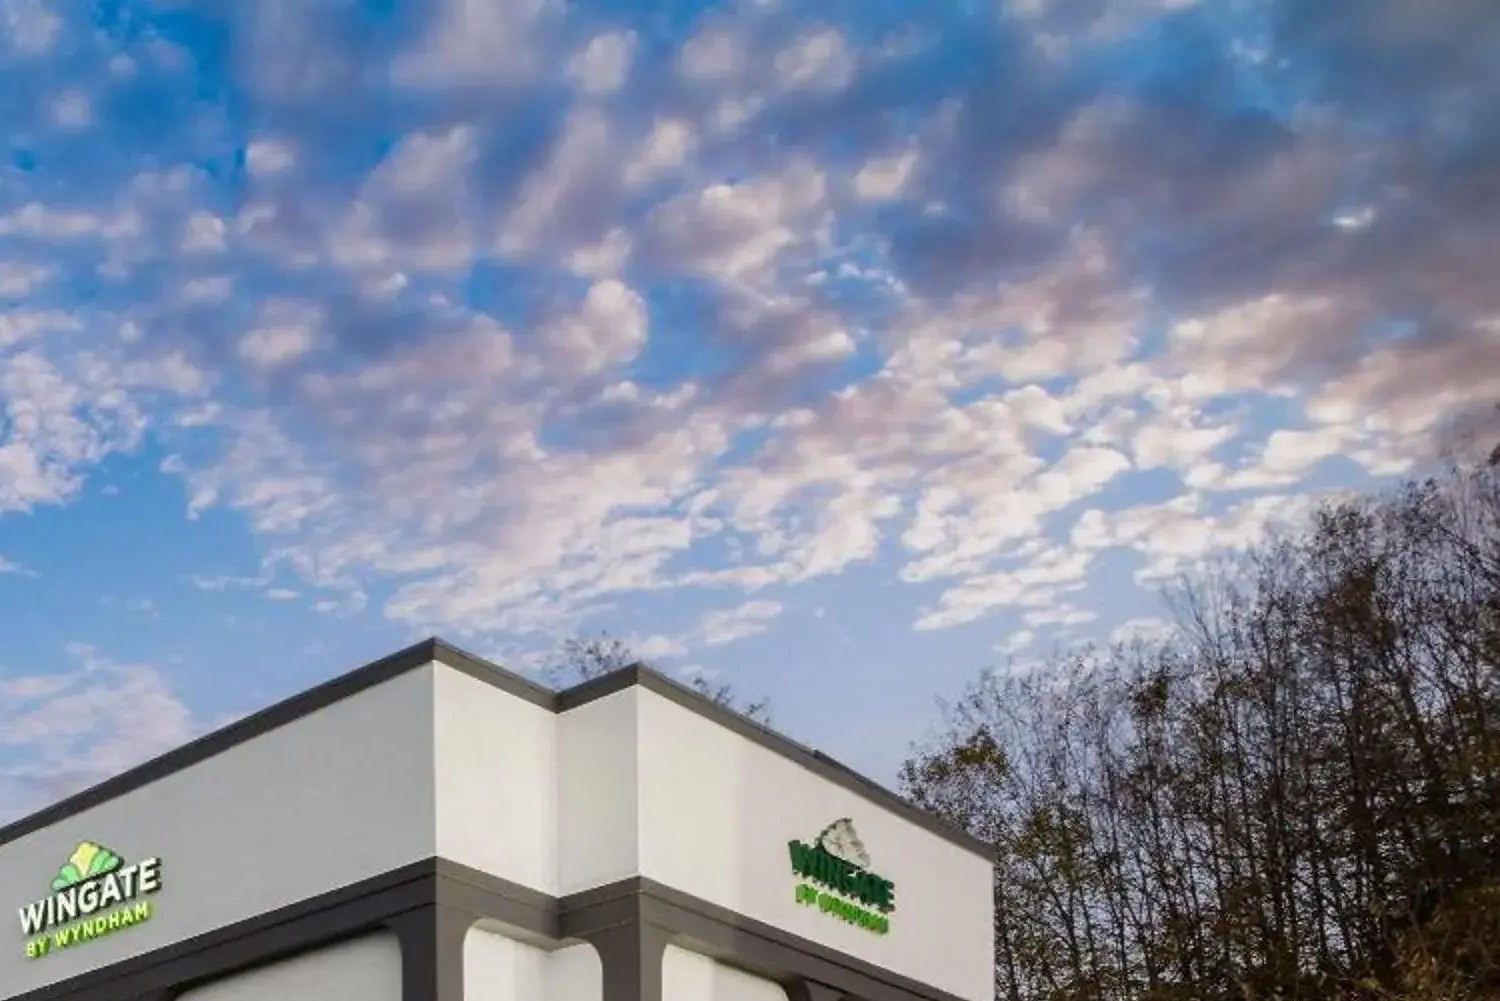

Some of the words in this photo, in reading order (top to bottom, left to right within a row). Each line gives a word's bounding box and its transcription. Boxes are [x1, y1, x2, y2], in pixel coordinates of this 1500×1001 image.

[18, 857, 160, 935] WINGATE
[25, 935, 51, 959] BY
[55, 901, 151, 948] WYNDHAM
